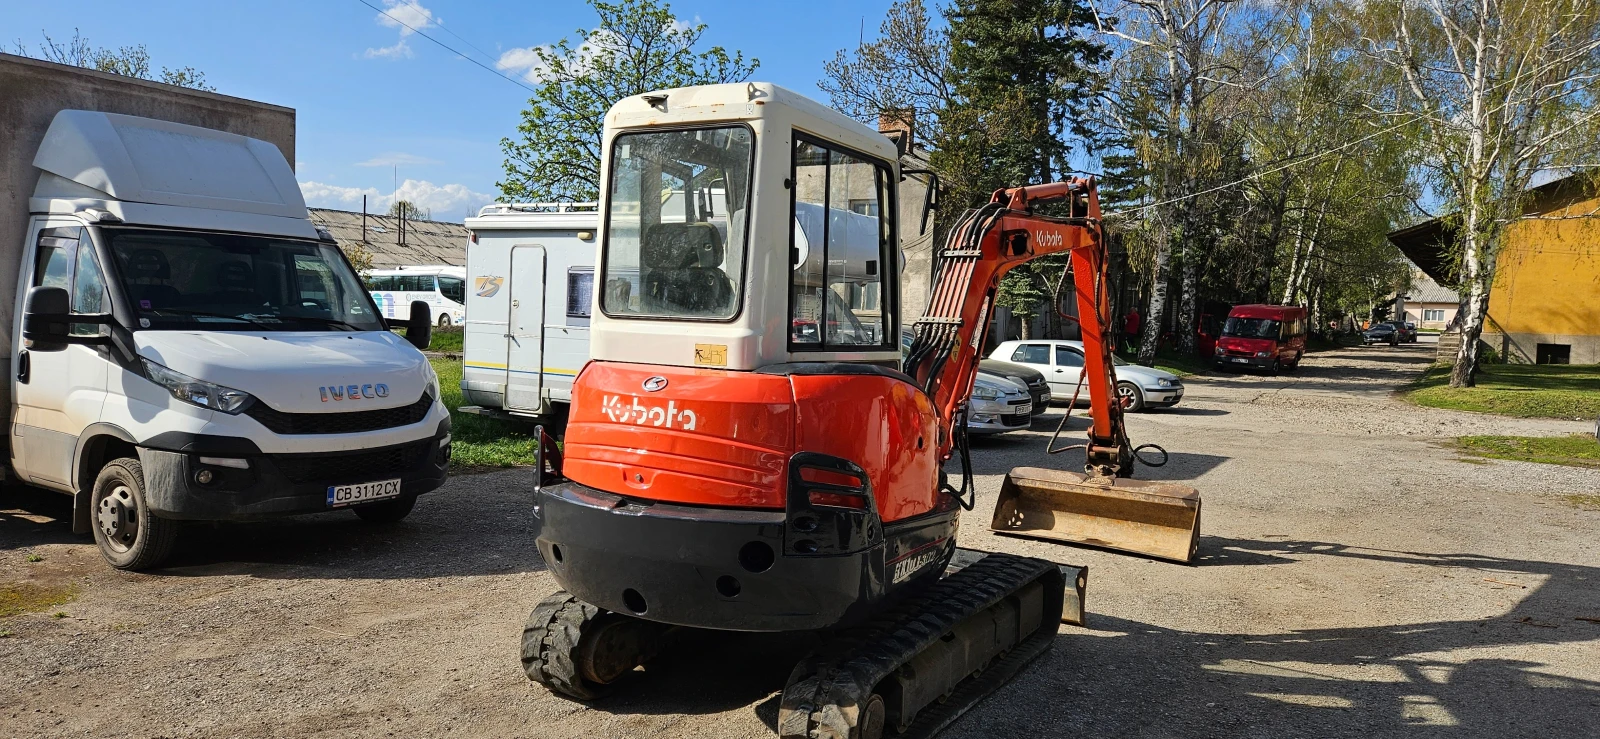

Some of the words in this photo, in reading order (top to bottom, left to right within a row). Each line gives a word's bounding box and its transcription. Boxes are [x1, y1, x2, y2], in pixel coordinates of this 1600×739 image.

[1036, 230, 1062, 247] Kubota
[319, 383, 390, 402] IVECO
[602, 395, 696, 430] Kubota
[336, 488, 352, 501] CB
[354, 484, 383, 499] 3112
[384, 481, 399, 495] CX
